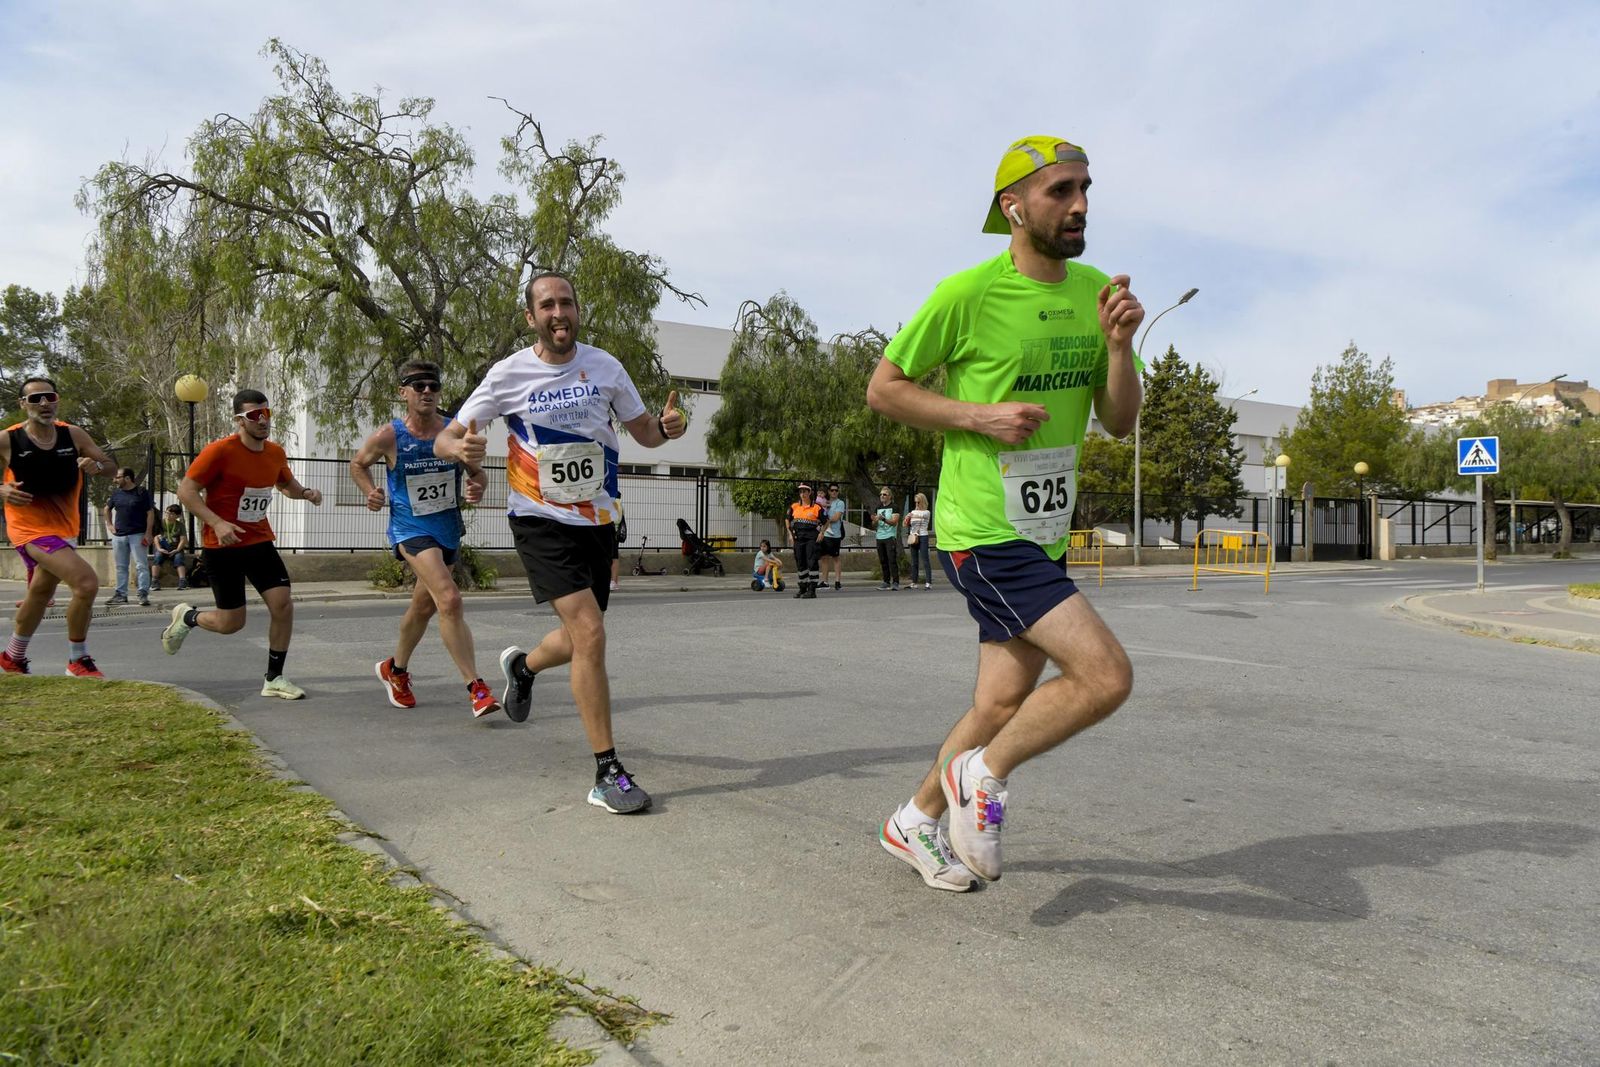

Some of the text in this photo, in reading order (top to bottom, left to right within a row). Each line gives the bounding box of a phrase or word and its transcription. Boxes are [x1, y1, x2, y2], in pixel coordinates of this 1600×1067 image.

[1049, 334, 1099, 351] MEMORIAL
[1051, 350, 1096, 370] PADRE
[404, 461, 428, 470] PAZITO
[551, 458, 594, 484] 506
[417, 482, 448, 502] 237
[1020, 476, 1068, 514] 625
[242, 498, 268, 511] 310
